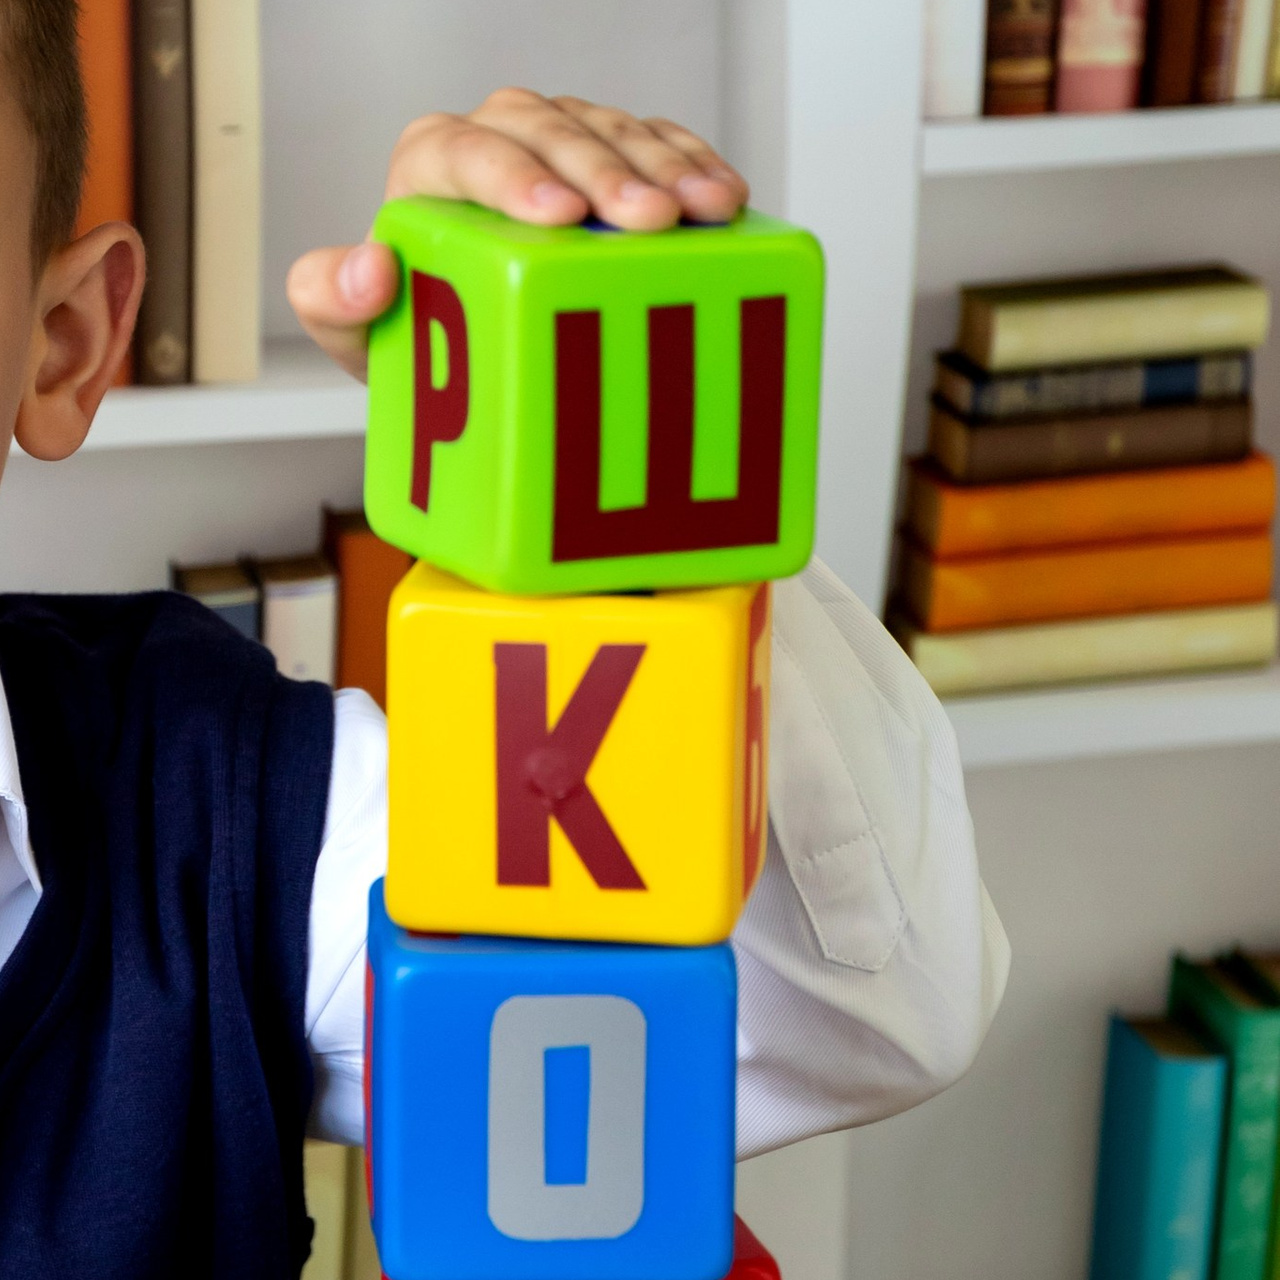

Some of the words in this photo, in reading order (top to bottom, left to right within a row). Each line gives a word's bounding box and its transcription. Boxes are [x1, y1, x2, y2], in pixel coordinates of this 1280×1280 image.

[553, 296, 786, 563] Ш
[494, 643, 648, 891] К
[488, 996, 646, 1239] О
